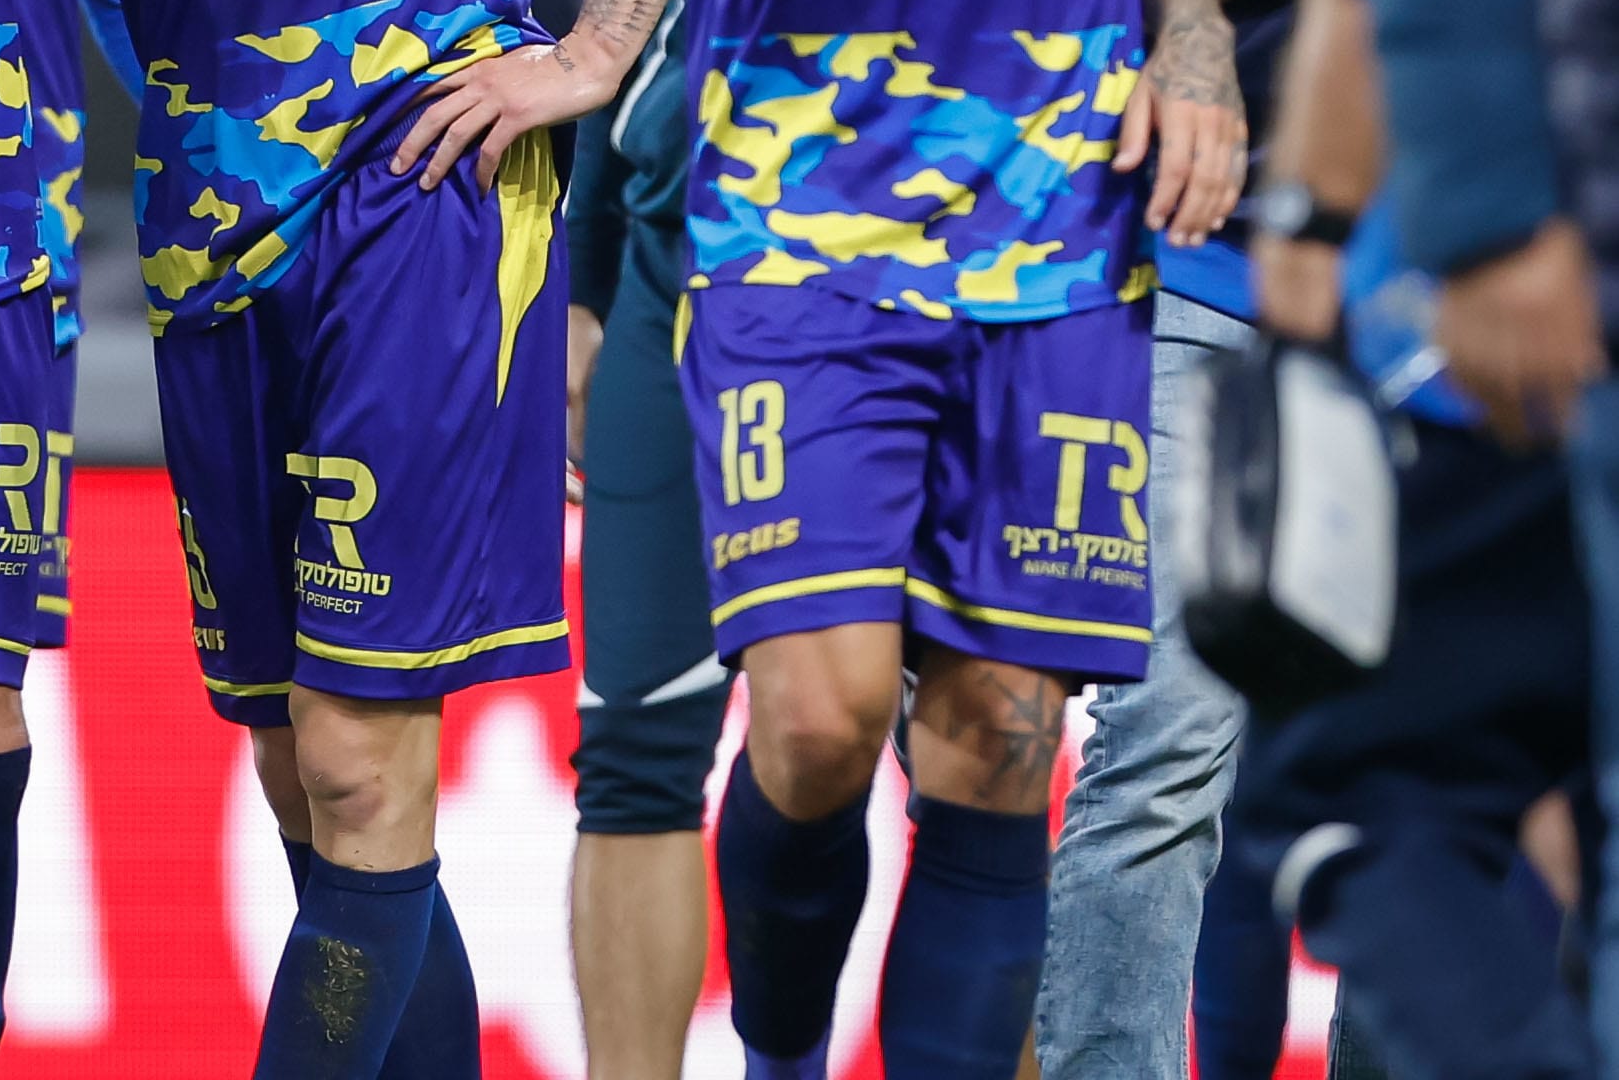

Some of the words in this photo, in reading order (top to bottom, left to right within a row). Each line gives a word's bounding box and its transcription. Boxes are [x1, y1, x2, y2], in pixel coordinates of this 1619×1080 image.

[718, 380, 785, 507] 13
[712, 517, 801, 571] Zeus
[306, 592, 363, 615] PERFECT
